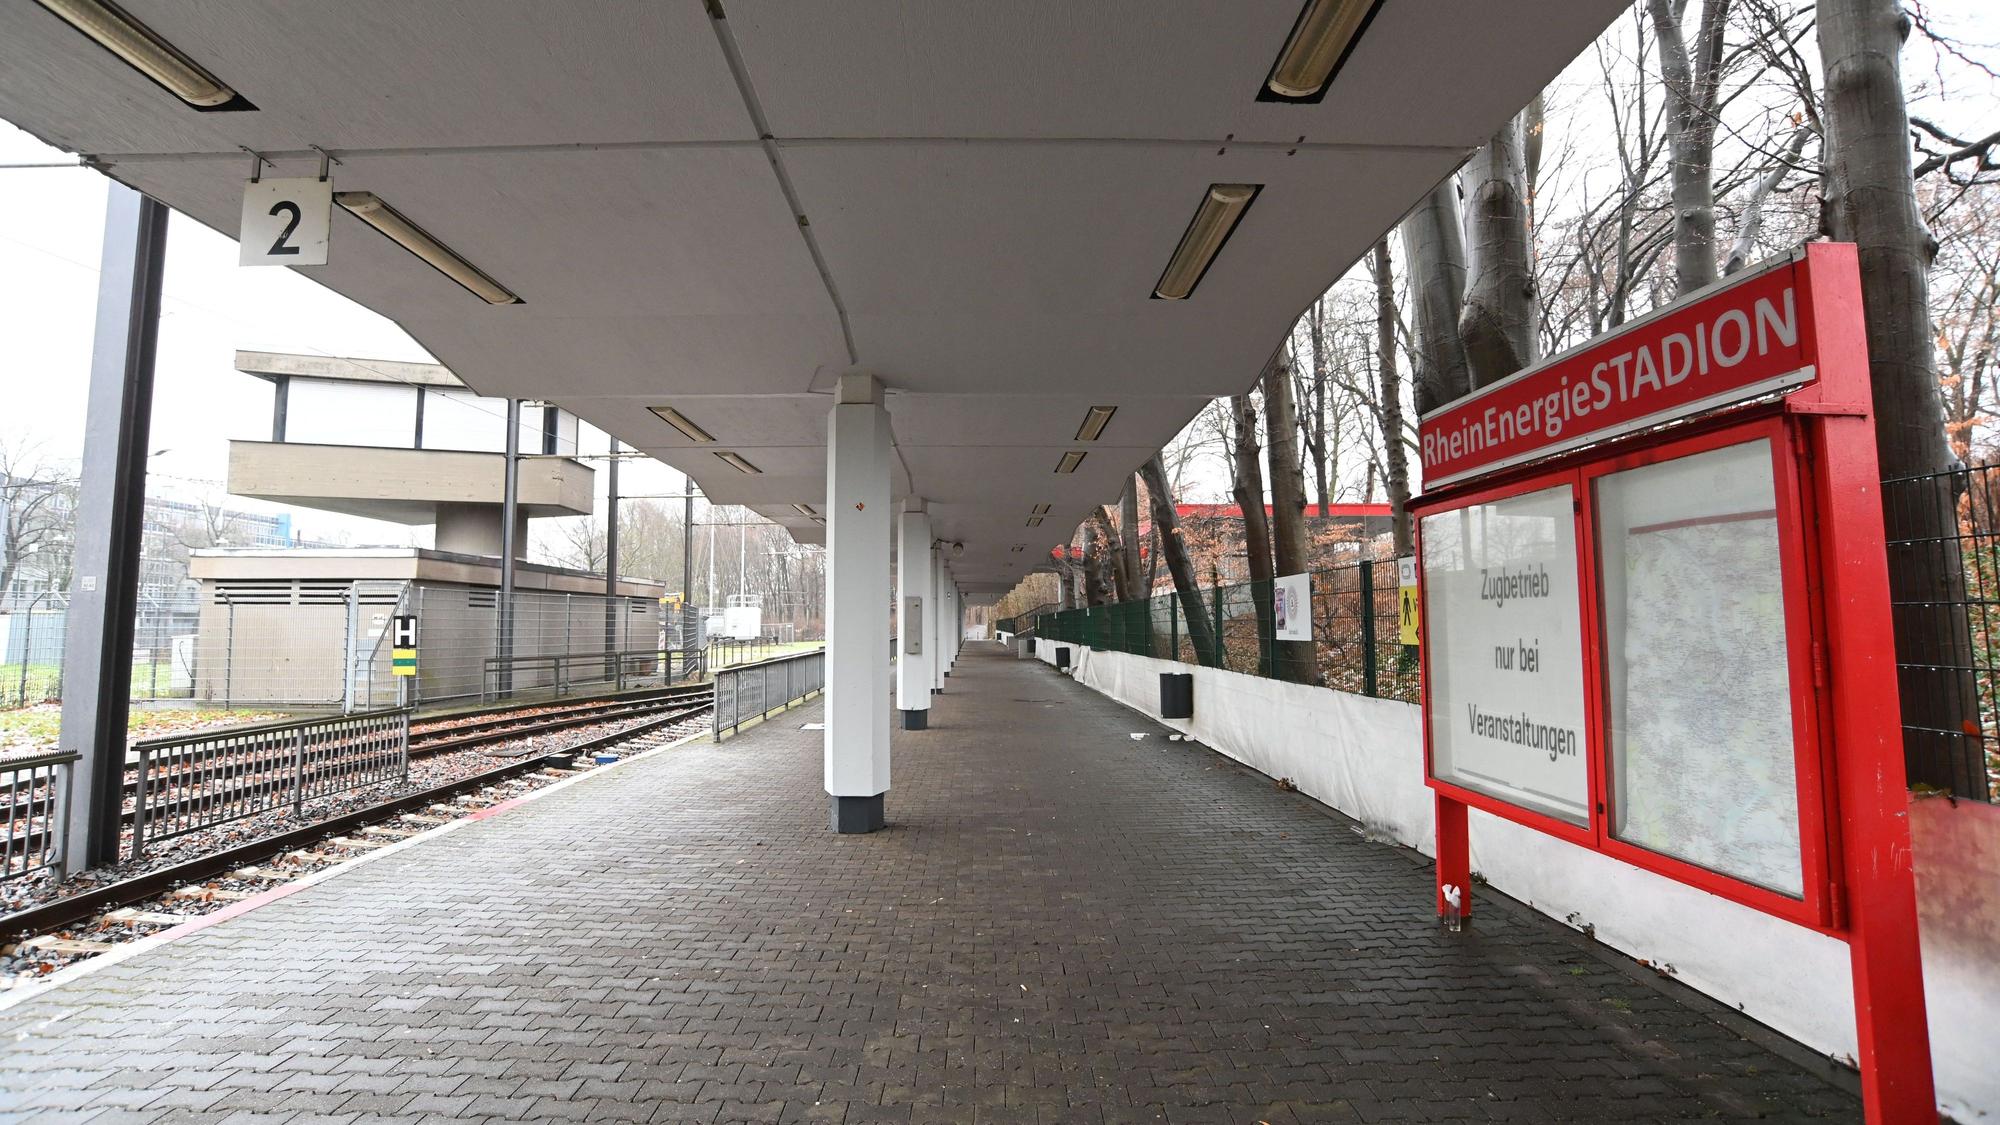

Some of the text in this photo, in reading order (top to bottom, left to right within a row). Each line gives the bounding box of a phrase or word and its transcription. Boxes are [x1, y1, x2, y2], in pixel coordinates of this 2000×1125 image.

[266, 200, 302, 256] 2
[1424, 288, 1798, 468] RheinEnergieSTADION
[1481, 564, 1549, 608] Zugbetrieb
[394, 618, 416, 646] H
[1494, 638, 1540, 673] nur bei
[1468, 703, 1577, 762] Veranstaltungen
